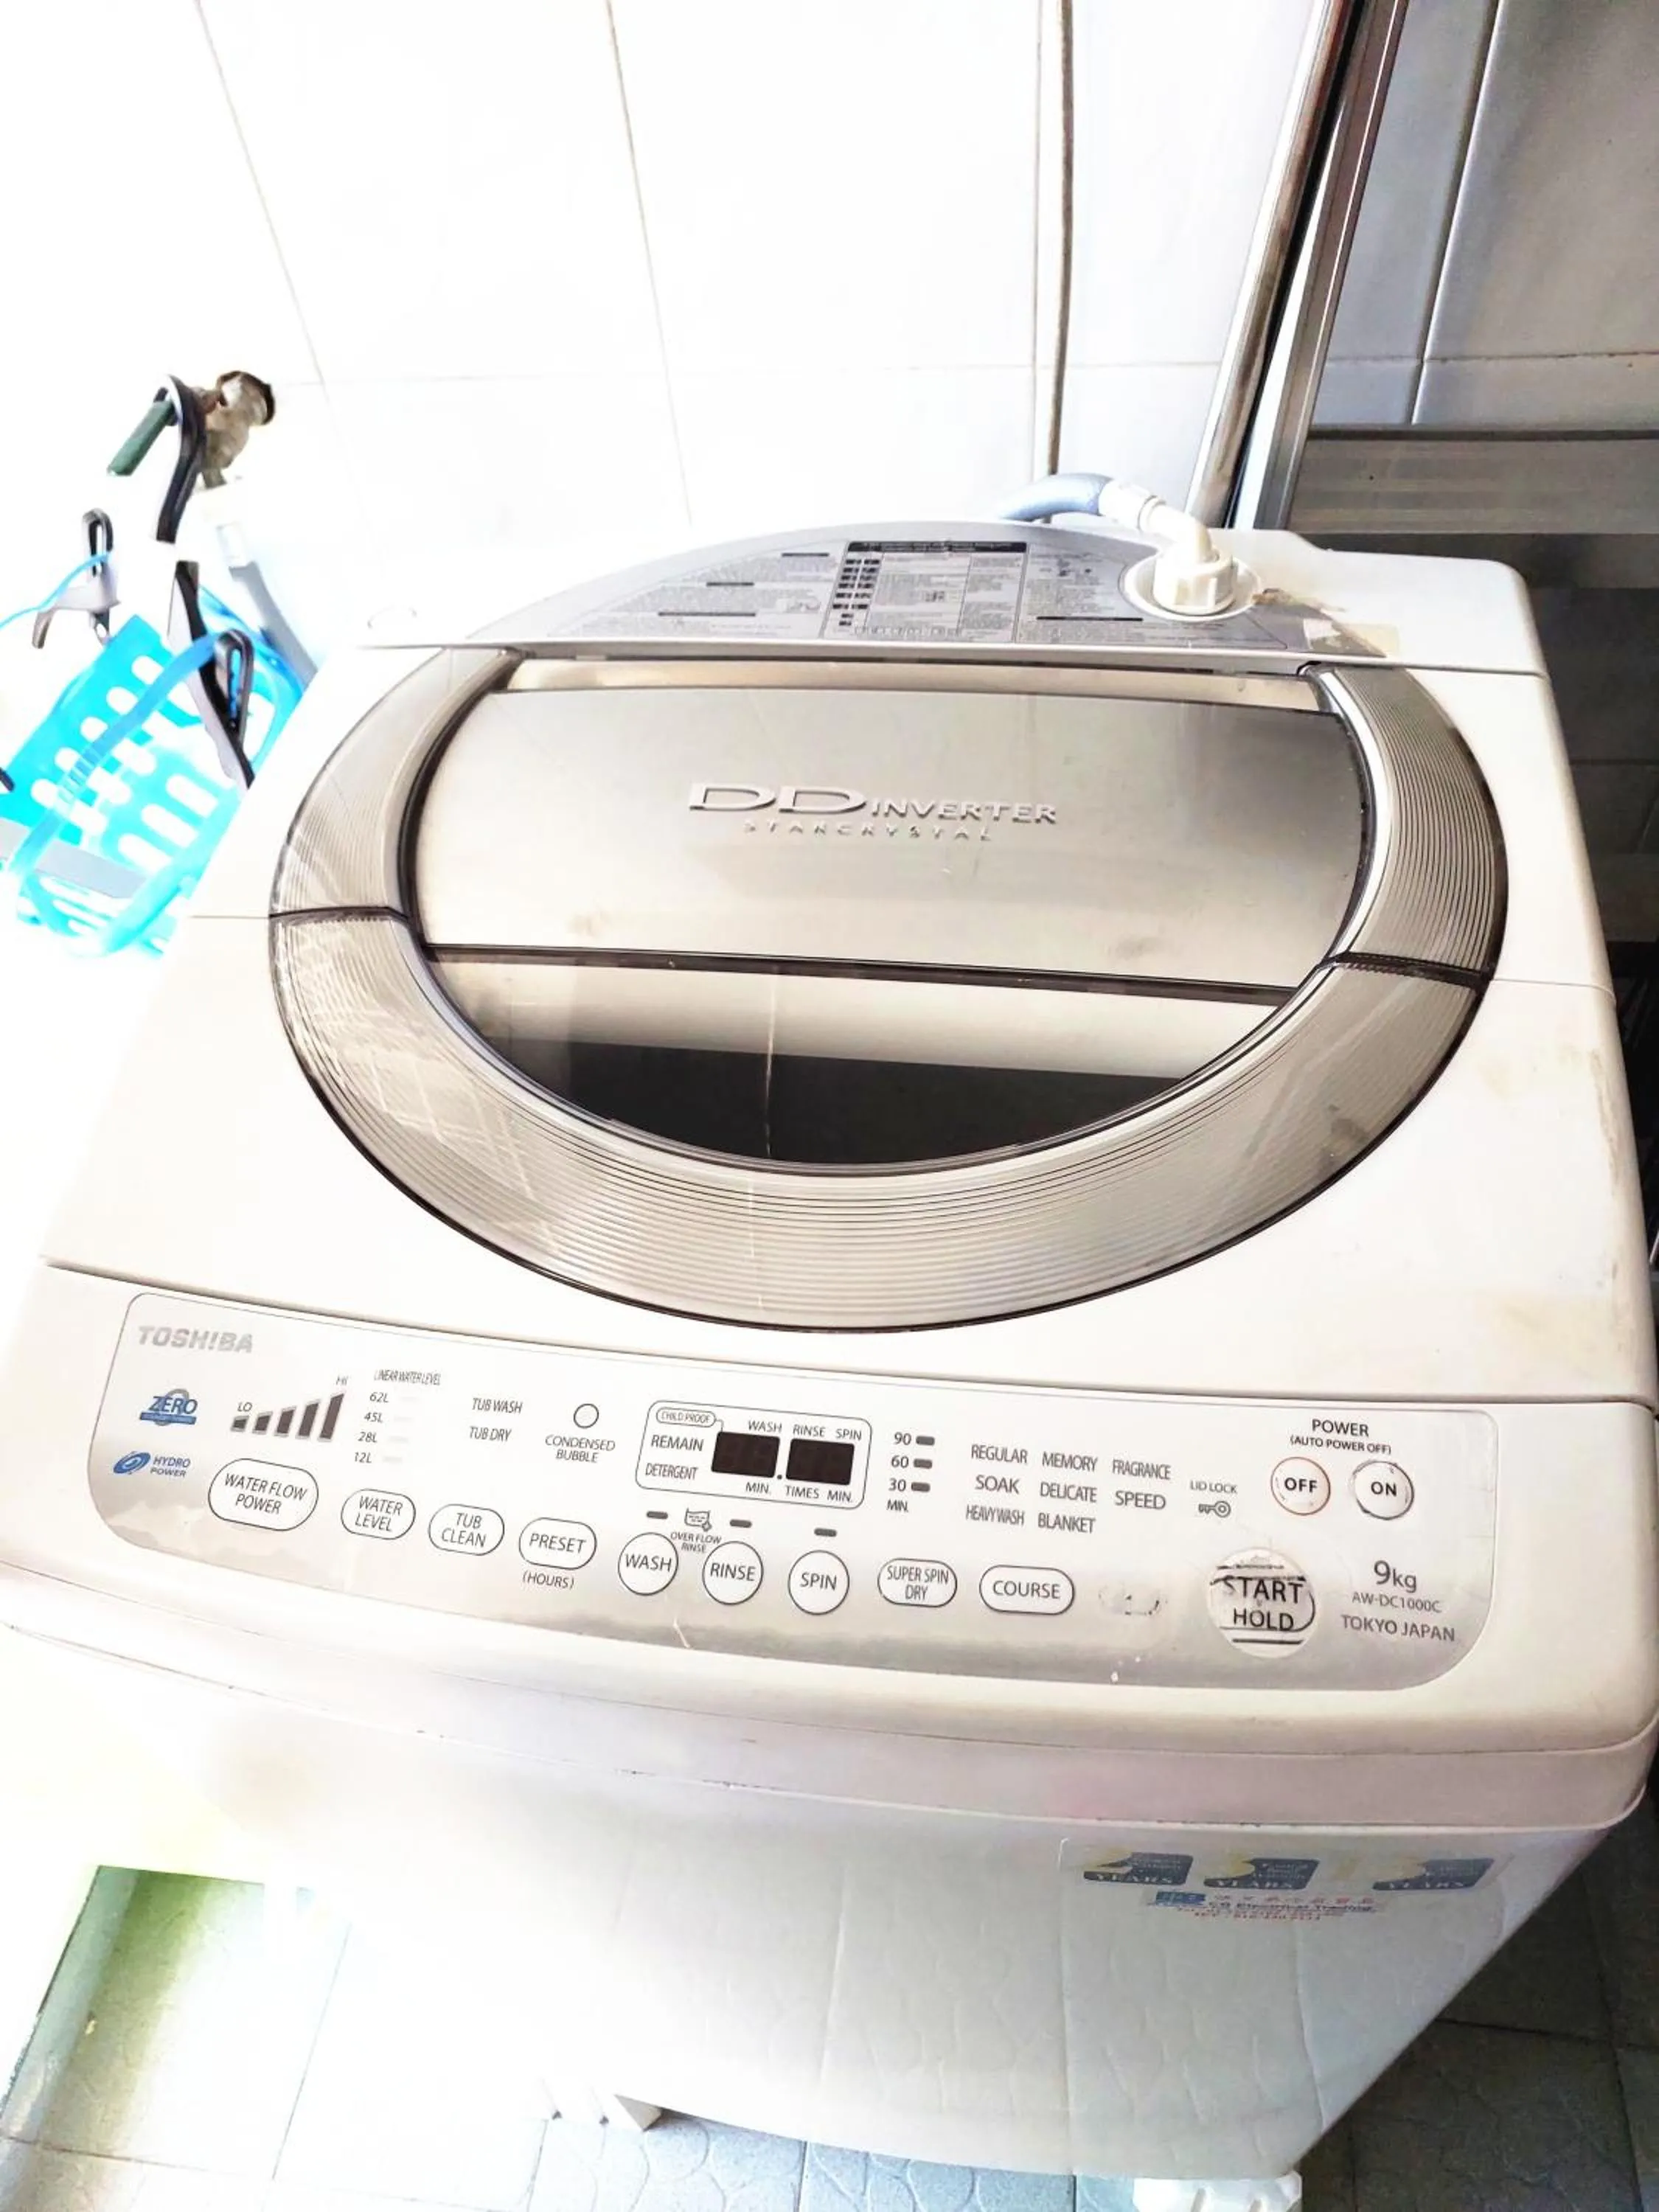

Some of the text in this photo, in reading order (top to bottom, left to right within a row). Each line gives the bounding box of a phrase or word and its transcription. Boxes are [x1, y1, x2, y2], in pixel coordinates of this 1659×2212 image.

[689, 783, 1057, 824] DD INVERTER
[139, 1326, 253, 1353] TOSHIBA
[374, 1369, 442, 1385] LINEAR WATER LEVEL
[149, 1395, 198, 1414] ZERO
[369, 1391, 389, 1403] 62L
[472, 1397, 524, 1414] TUB WASH
[237, 1401, 253, 1412] LO
[364, 1411, 383, 1423] 45L
[661, 1411, 711, 1425] CHILD PROOF
[748, 1419, 782, 1433] WASH
[358, 1431, 378, 1443] 28L
[469, 1425, 512, 1442] TUB DRY
[793, 1423, 826, 1438] RINSE
[835, 1427, 863, 1441] SPIN
[1312, 1419, 1369, 1438] POWER
[545, 1434, 615, 1452] CONDENSED
[650, 1434, 704, 1453] REMAIN
[894, 1432, 911, 1446] 90
[1290, 1434, 1392, 1455] (AUTO POWER OFF)
[153, 1455, 191, 1467] HYDRO
[353, 1451, 372, 1464] 12L
[556, 1450, 599, 1464] BUBBLE
[891, 1455, 910, 1469] 60
[971, 1444, 1028, 1464] REGULAR
[1042, 1452, 1098, 1472] MEMORY
[150, 1467, 187, 1478] POWER
[645, 1462, 698, 1481] DETERGENT
[1112, 1459, 1172, 1481] FRAGRANCE
[225, 1473, 308, 1500] WATER FLOW
[745, 1481, 772, 1495] MIN.
[785, 1485, 819, 1499] TIMES
[888, 1478, 907, 1492] 30
[975, 1475, 1020, 1494] SOAK
[1040, 1482, 1097, 1503] DELICATE
[1190, 1479, 1238, 1495] LID LOCK
[1284, 1477, 1318, 1494] OFF
[1370, 1481, 1397, 1498] ON
[235, 1493, 281, 1515] POWER
[827, 1489, 853, 1503] MIN.
[1115, 1492, 1166, 1510] SPEED
[358, 1496, 403, 1517] WATER
[886, 1499, 909, 1513] MIN.
[355, 1512, 393, 1533] LEVEL
[456, 1512, 482, 1530] TUB
[1037, 1513, 1096, 1534] BLANKET
[442, 1528, 487, 1548] CLEAN
[529, 1533, 585, 1555] PRESET
[670, 1531, 722, 1544] OVER FLOW
[681, 1543, 706, 1554] RINSE
[625, 1553, 672, 1573] WASH
[710, 1562, 756, 1582] RINSE
[522, 1570, 574, 1590] (HOURS)
[800, 1571, 837, 1590] SPIN
[886, 1565, 950, 1585] SUPER SPIN
[1373, 1559, 1417, 1593] 9kg
[905, 1585, 928, 1601] DRY
[992, 1580, 1061, 1599] COURSE
[1352, 1591, 1443, 1613] AW-DC1000C
[1233, 1607, 1294, 1631] HOLD
[1340, 1614, 1455, 1642] TOKYO JAPAN
